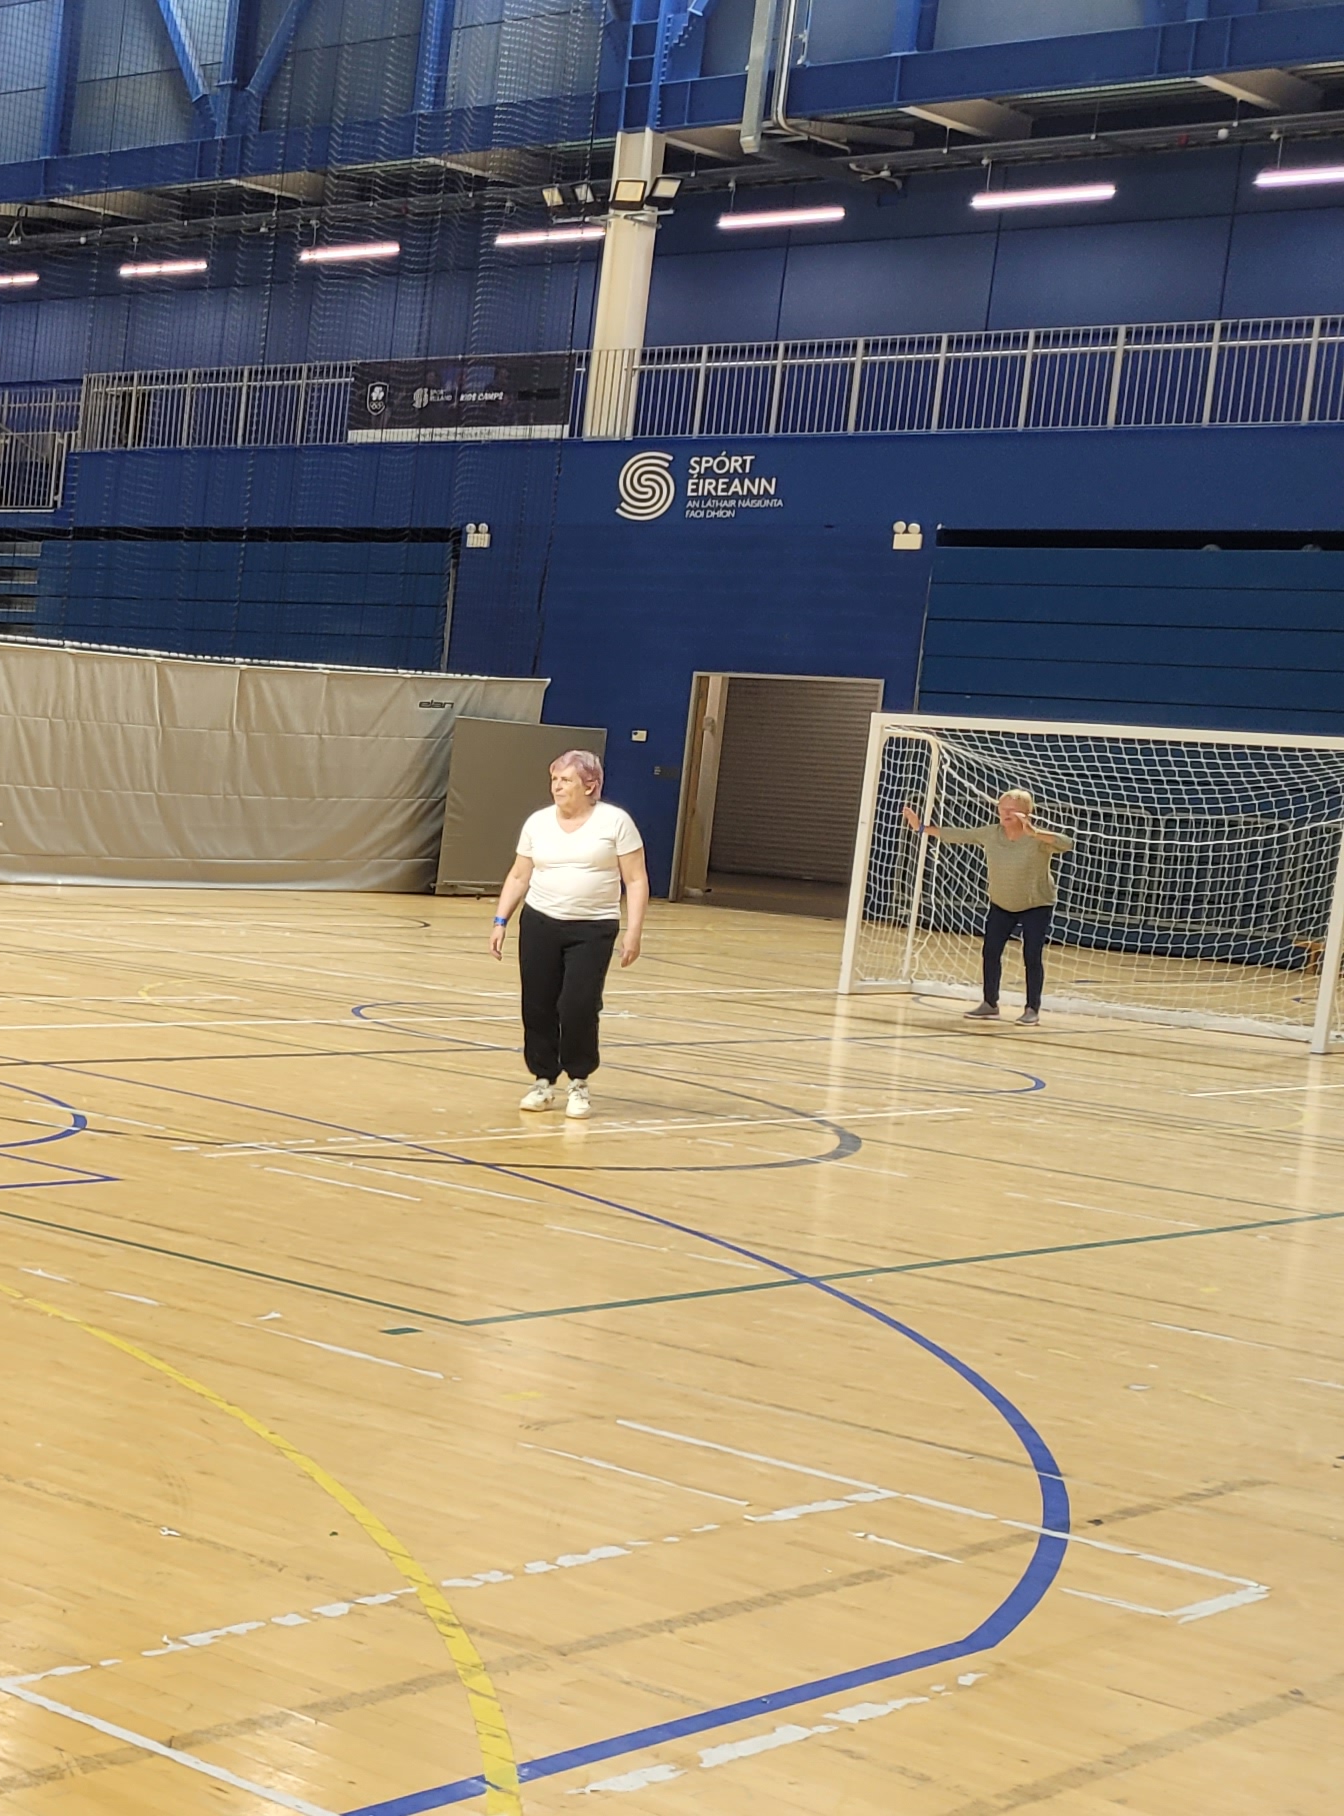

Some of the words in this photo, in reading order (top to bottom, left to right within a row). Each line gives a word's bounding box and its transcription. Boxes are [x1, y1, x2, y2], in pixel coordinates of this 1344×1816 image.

[688, 451, 755, 474] SPÓRT
[686, 474, 777, 497] ÉIREANN
[686, 500, 700, 508] AN
[701, 498, 737, 508] LÁTHAIR
[738, 497, 784, 508] NÁISIÚNTA
[685, 509, 704, 518] FAOI
[705, 508, 735, 518] DHÍON
[418, 699, 454, 709] elan
